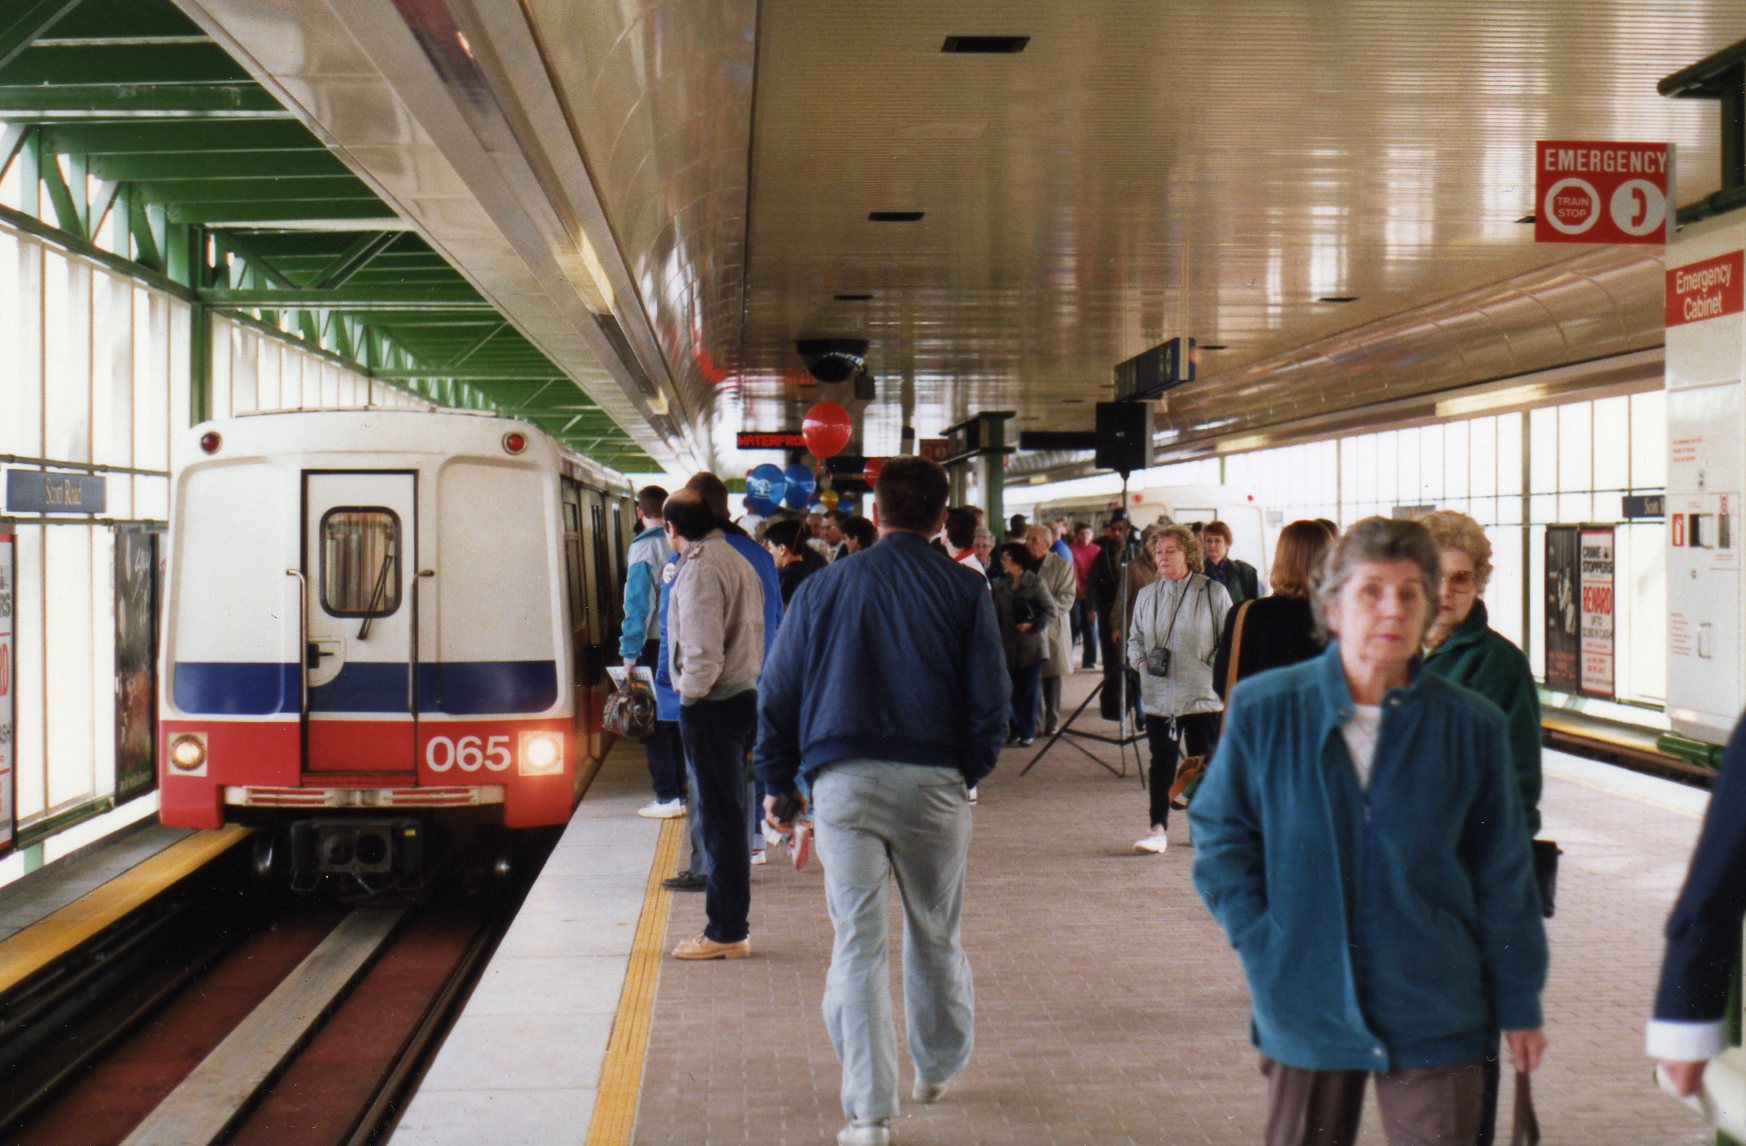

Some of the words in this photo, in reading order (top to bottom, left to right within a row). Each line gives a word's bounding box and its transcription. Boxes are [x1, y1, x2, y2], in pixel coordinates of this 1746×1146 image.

[1544, 149, 1667, 173] EMERGENCY
[1557, 197, 1589, 206] TRAIN
[1558, 209, 1586, 218] STOP
[1676, 263, 1732, 295] Emergency
[1683, 293, 1722, 321] Cabinet
[1583, 586, 1612, 615] REWARD
[426, 736, 512, 772] 065
